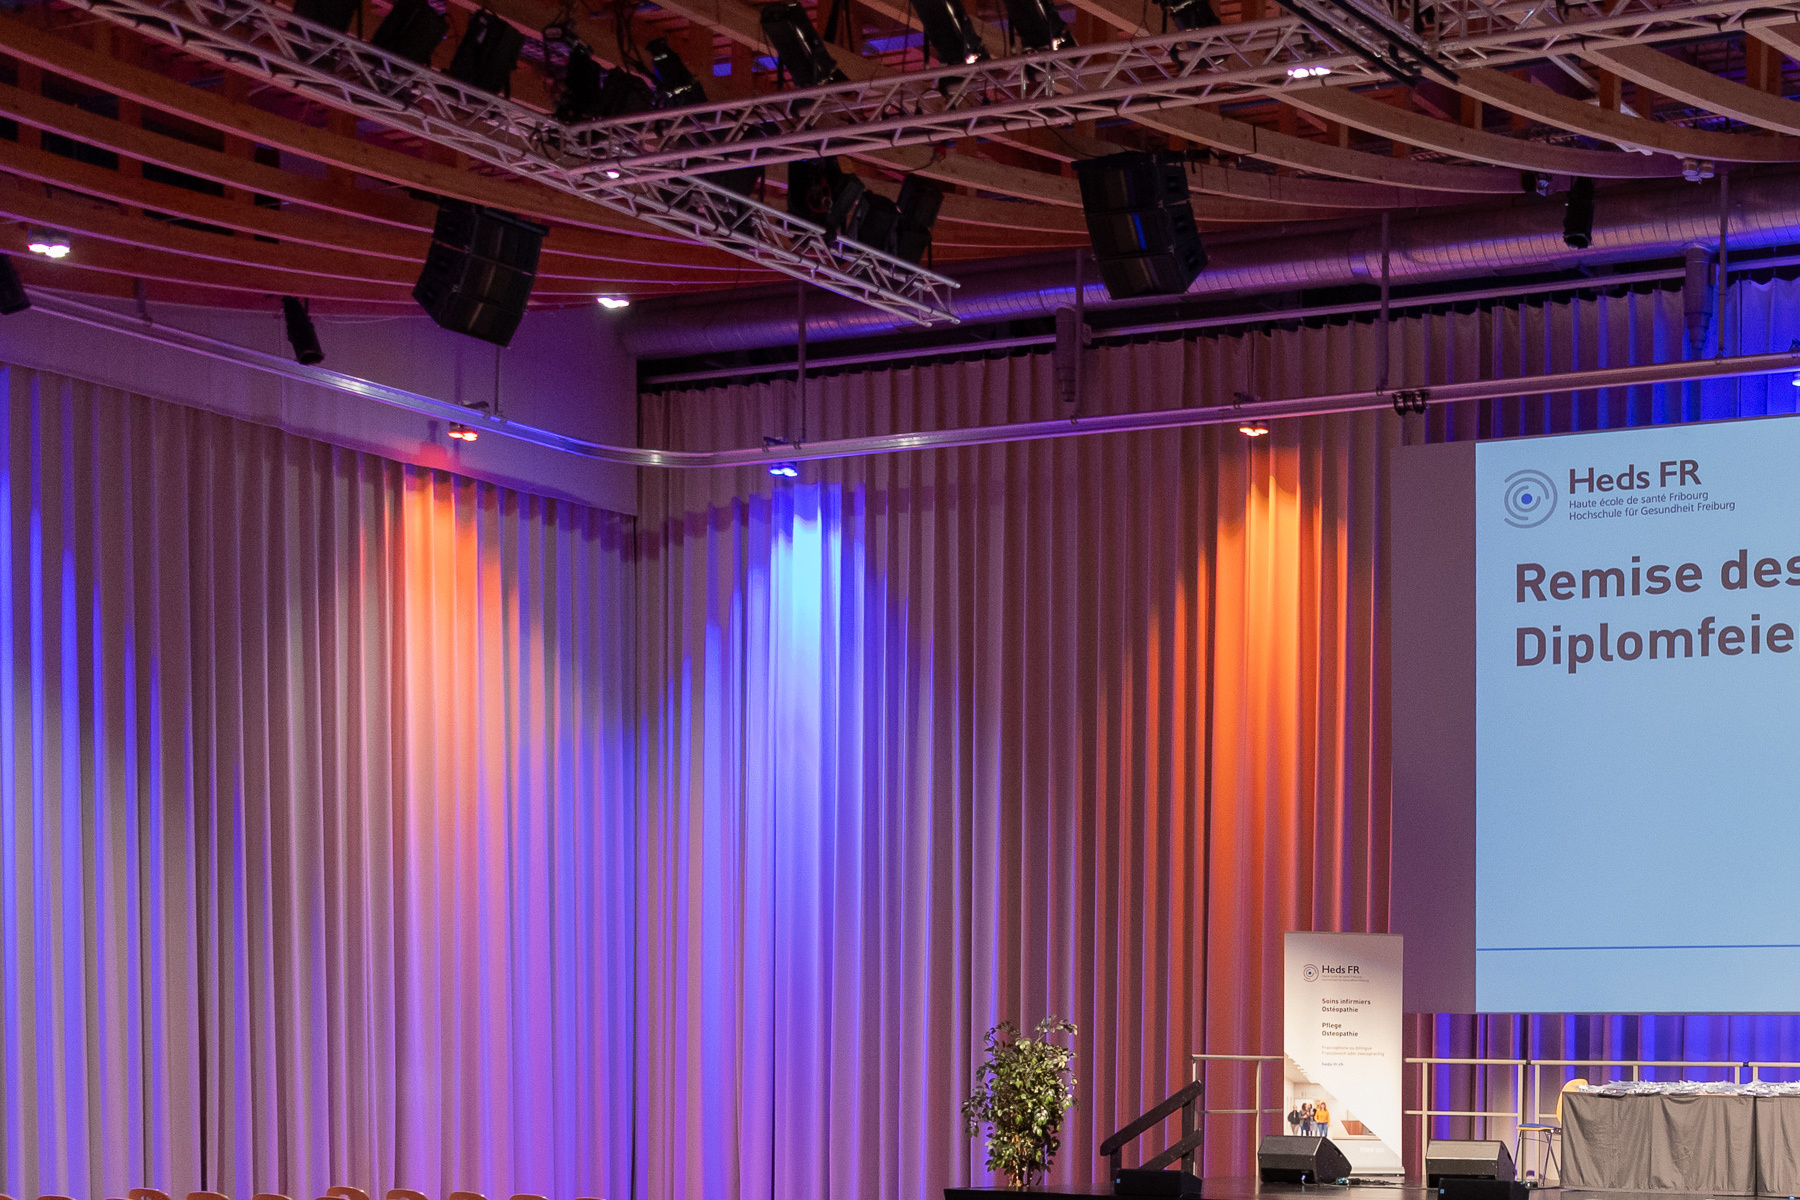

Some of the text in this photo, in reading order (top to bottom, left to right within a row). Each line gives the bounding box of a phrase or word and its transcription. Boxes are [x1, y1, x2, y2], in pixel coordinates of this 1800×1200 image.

[1569, 459, 1702, 494] Heds FR
[1569, 490, 1709, 509] Haute école de santé Fribourg
[1569, 501, 1736, 521] Hochschule für Gesundheit Freiburg
[1516, 556, 1703, 603] Remise
[1321, 965, 1360, 974] Heds FR
[1321, 1022, 1342, 1030] Pflege
